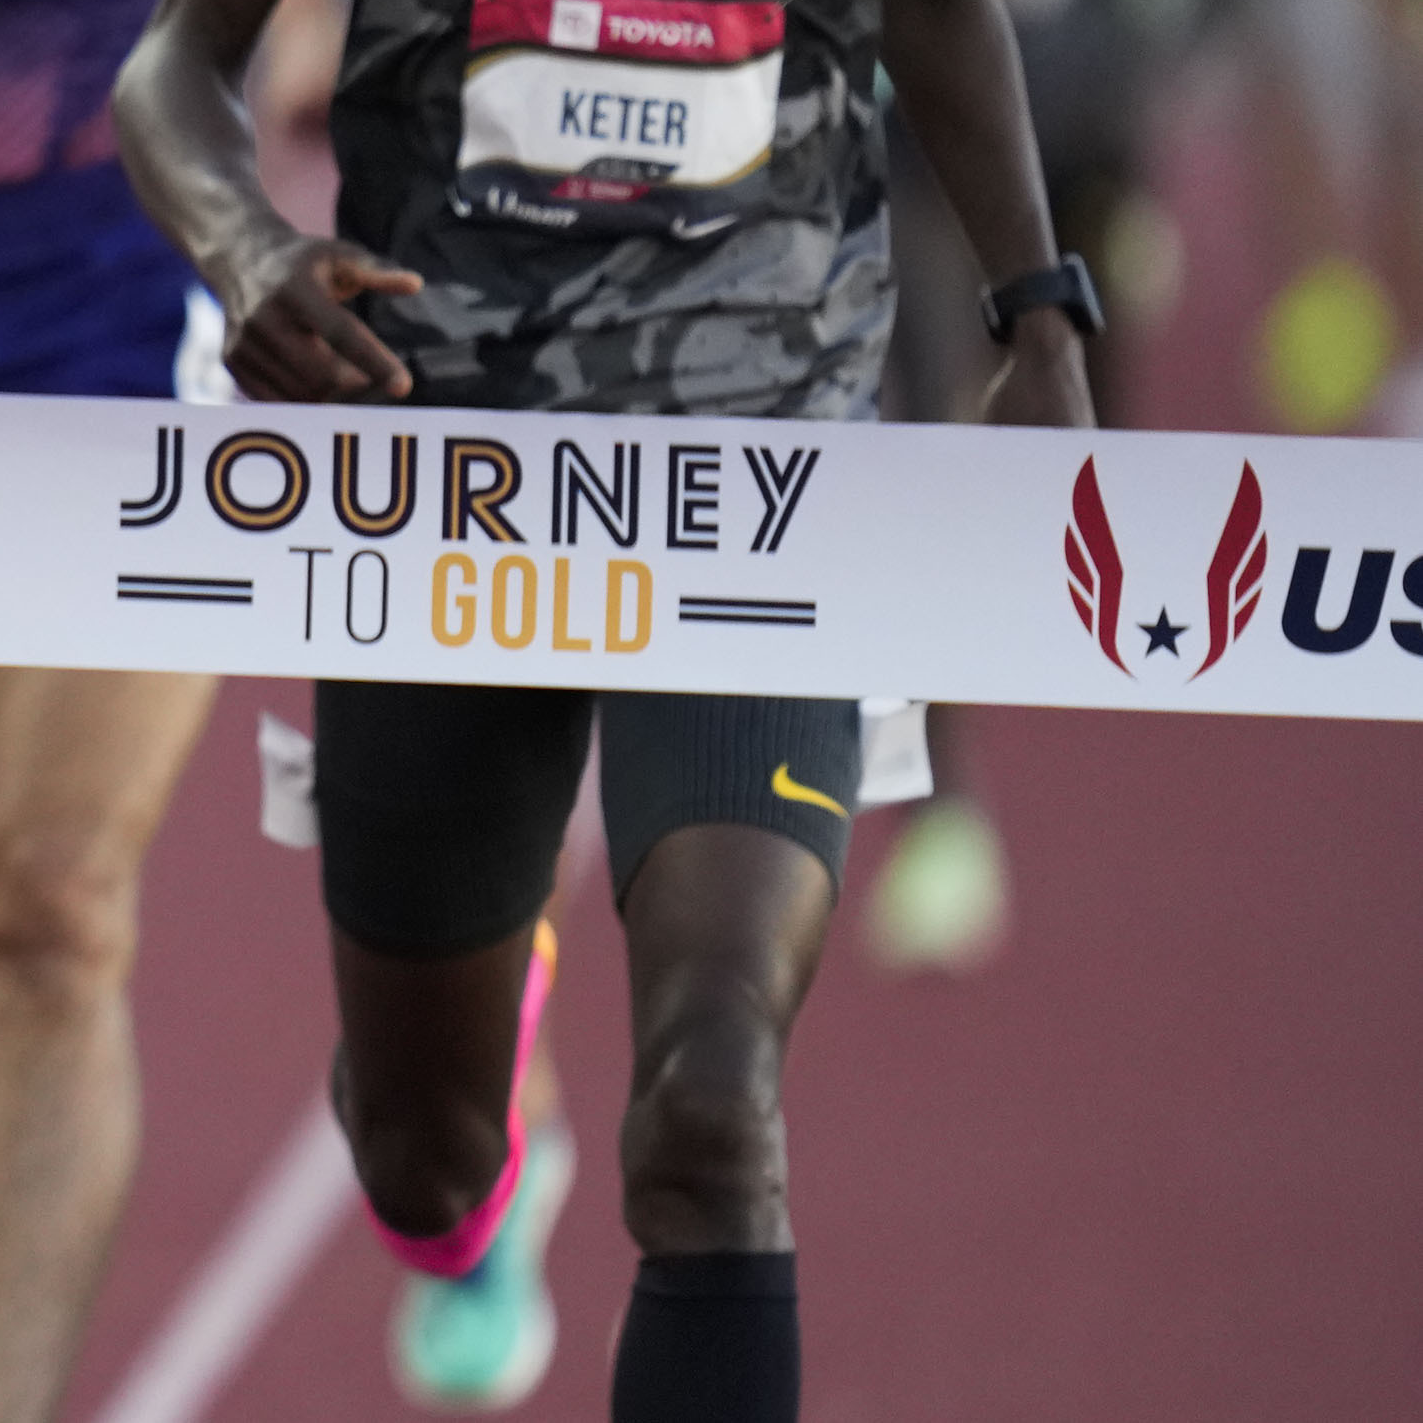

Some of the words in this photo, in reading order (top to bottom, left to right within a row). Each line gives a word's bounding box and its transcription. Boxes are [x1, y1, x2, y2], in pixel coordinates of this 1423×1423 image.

[608, 15, 715, 49] TOYOTA
[559, 89, 689, 147] KETER
[120, 426, 821, 553] JOURNEY
[289, 546, 389, 645] TO
[431, 554, 653, 653] GOLD
